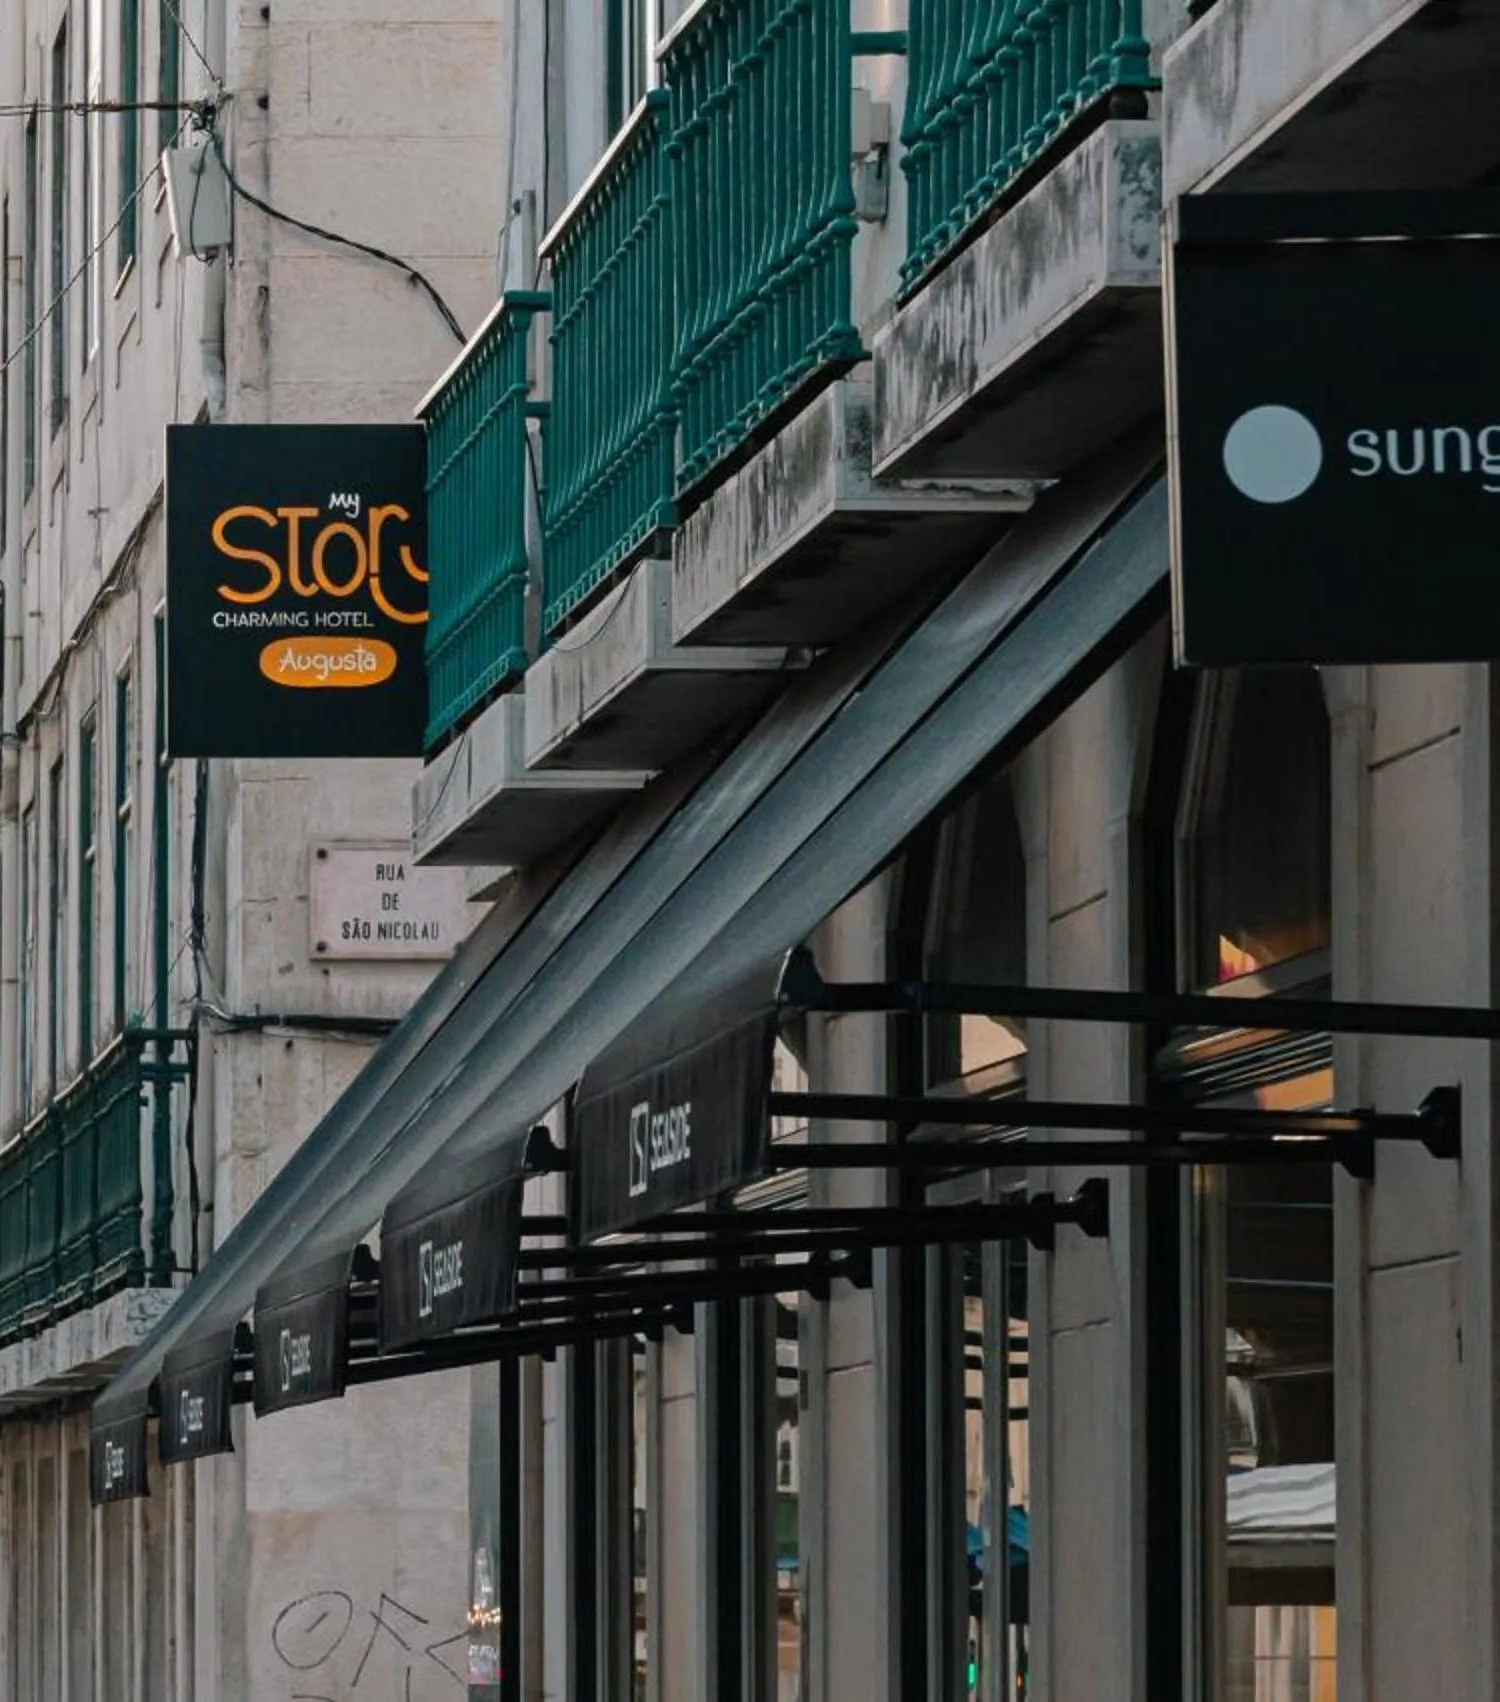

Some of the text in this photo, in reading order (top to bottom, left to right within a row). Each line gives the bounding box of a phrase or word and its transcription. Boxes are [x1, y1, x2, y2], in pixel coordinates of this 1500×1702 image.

[212, 611, 375, 628] CHARMING HOTEL
[278, 646, 377, 681] Augusta
[375, 863, 405, 881] RUA
[381, 893, 400, 911] DE
[341, 917, 439, 941] SÃO NICOLAU
